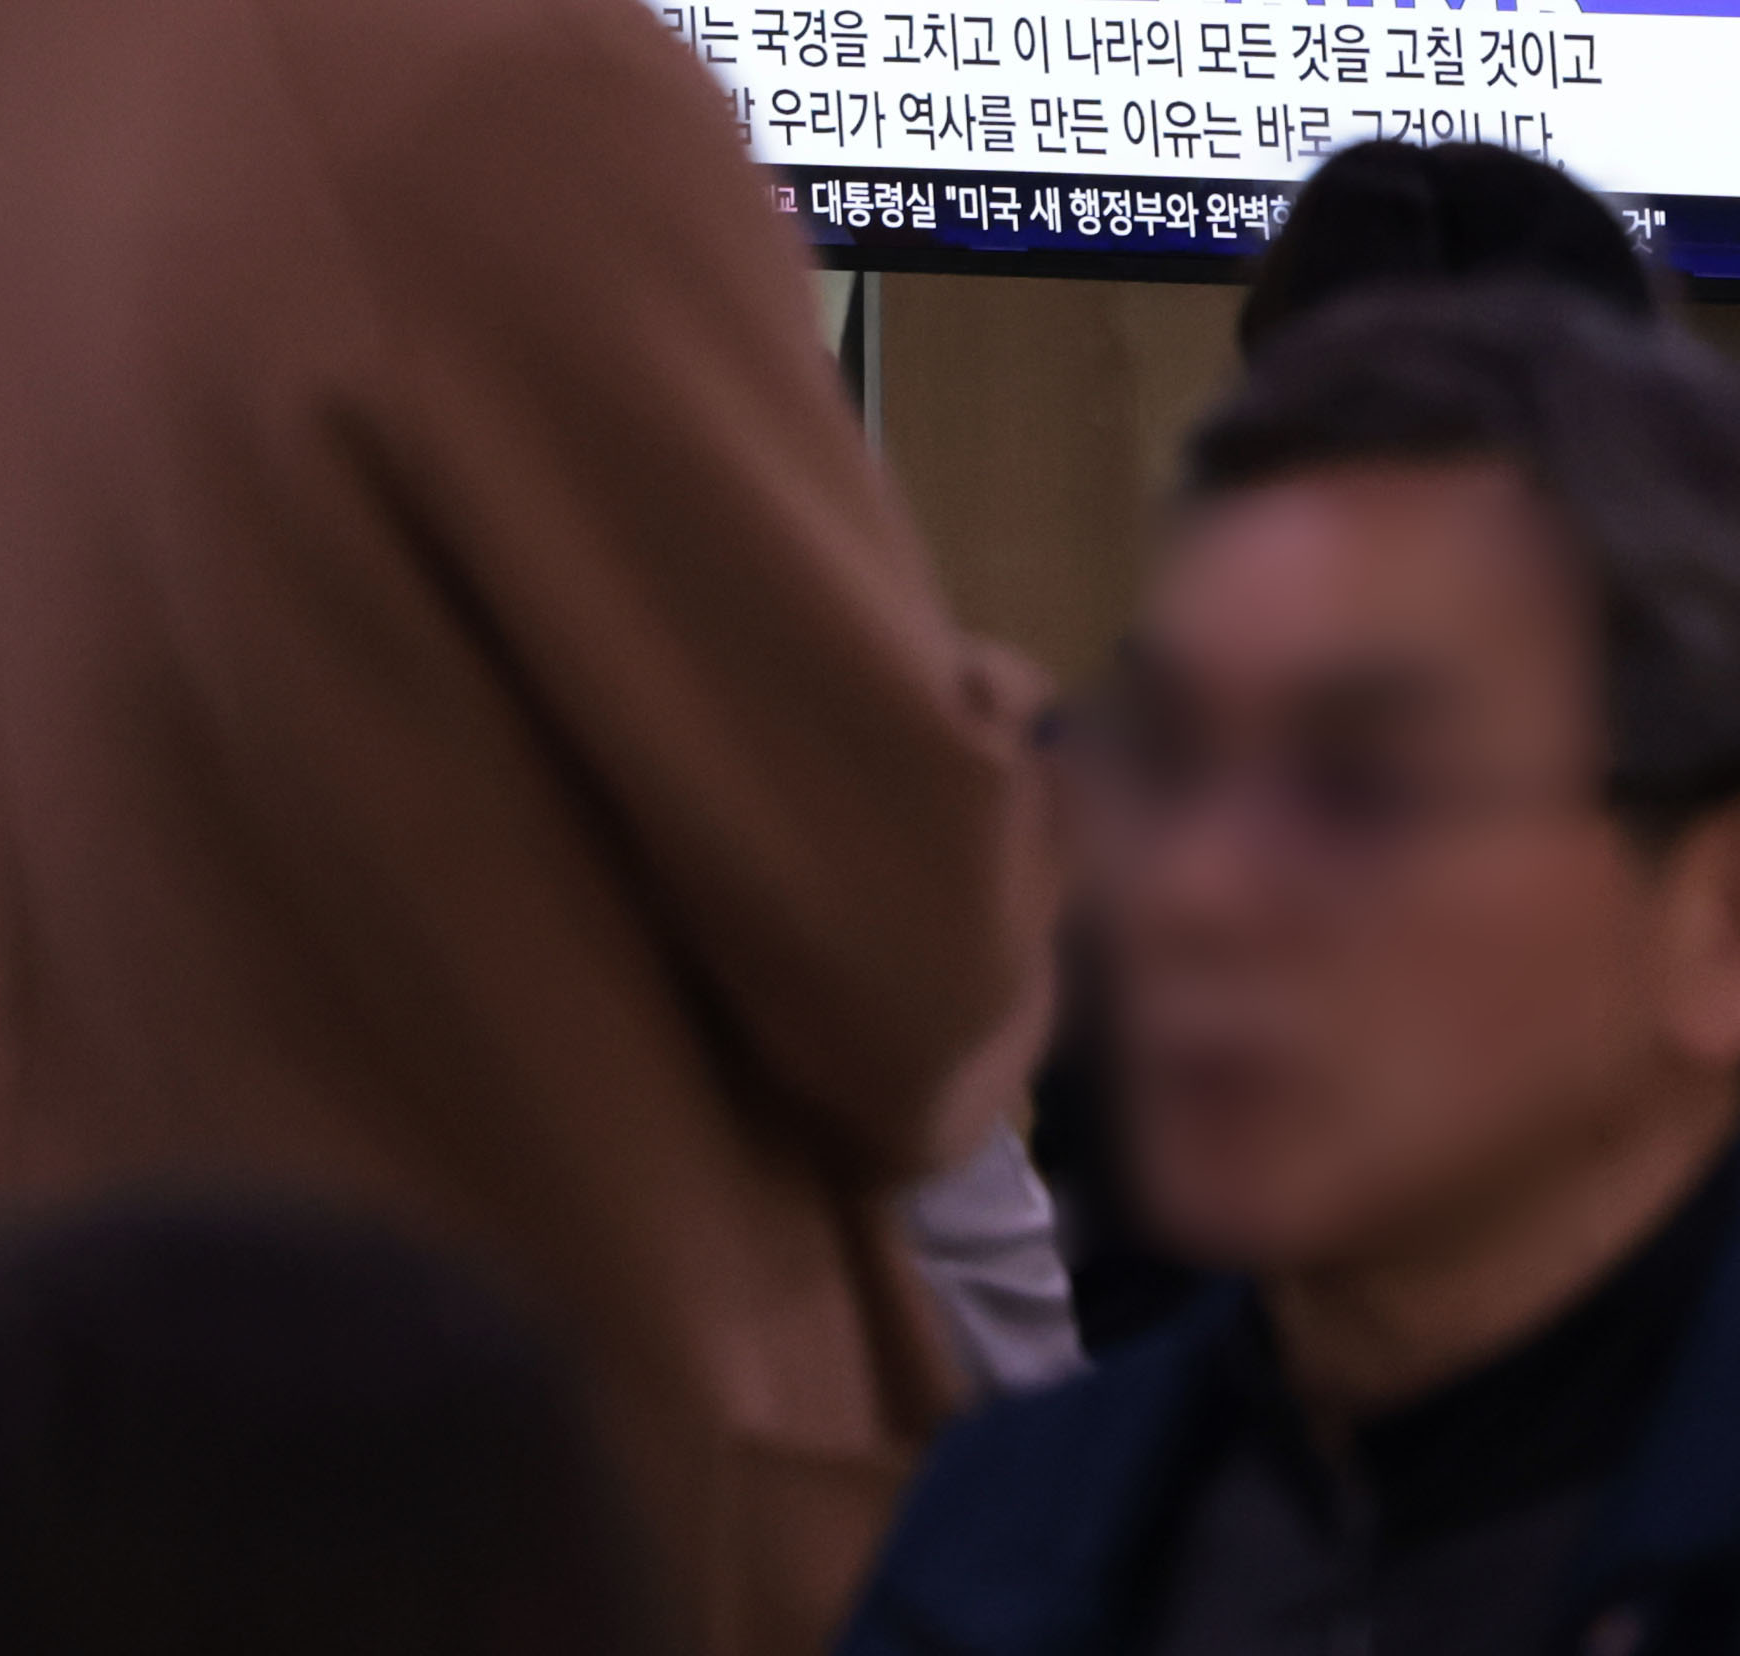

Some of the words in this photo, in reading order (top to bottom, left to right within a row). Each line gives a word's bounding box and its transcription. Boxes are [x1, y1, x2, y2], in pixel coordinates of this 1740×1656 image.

[751, 8, 868, 68] 국경을
[883, 12, 1001, 71] 고치고
[1014, 15, 1050, 74] 이
[1066, 16, 1184, 78] 나라의
[1198, 23, 1277, 79] 모든
[1292, 23, 1371, 83] 것을
[1385, 26, 1466, 86] 고칠
[1480, 28, 1603, 89] 것이고
[769, 89, 886, 148] 우리가
[899, 92, 1017, 152] 역사를
[1030, 96, 1109, 155] 만든
[1123, 99, 1242, 159] 이유는
[1256, 104, 1335, 162] 바로
[811, 179, 937, 229] 대통령실
[945, 183, 1022, 232] "미국
[1030, 186, 1061, 233] 새
[1068, 187, 1199, 238] 행정부와
